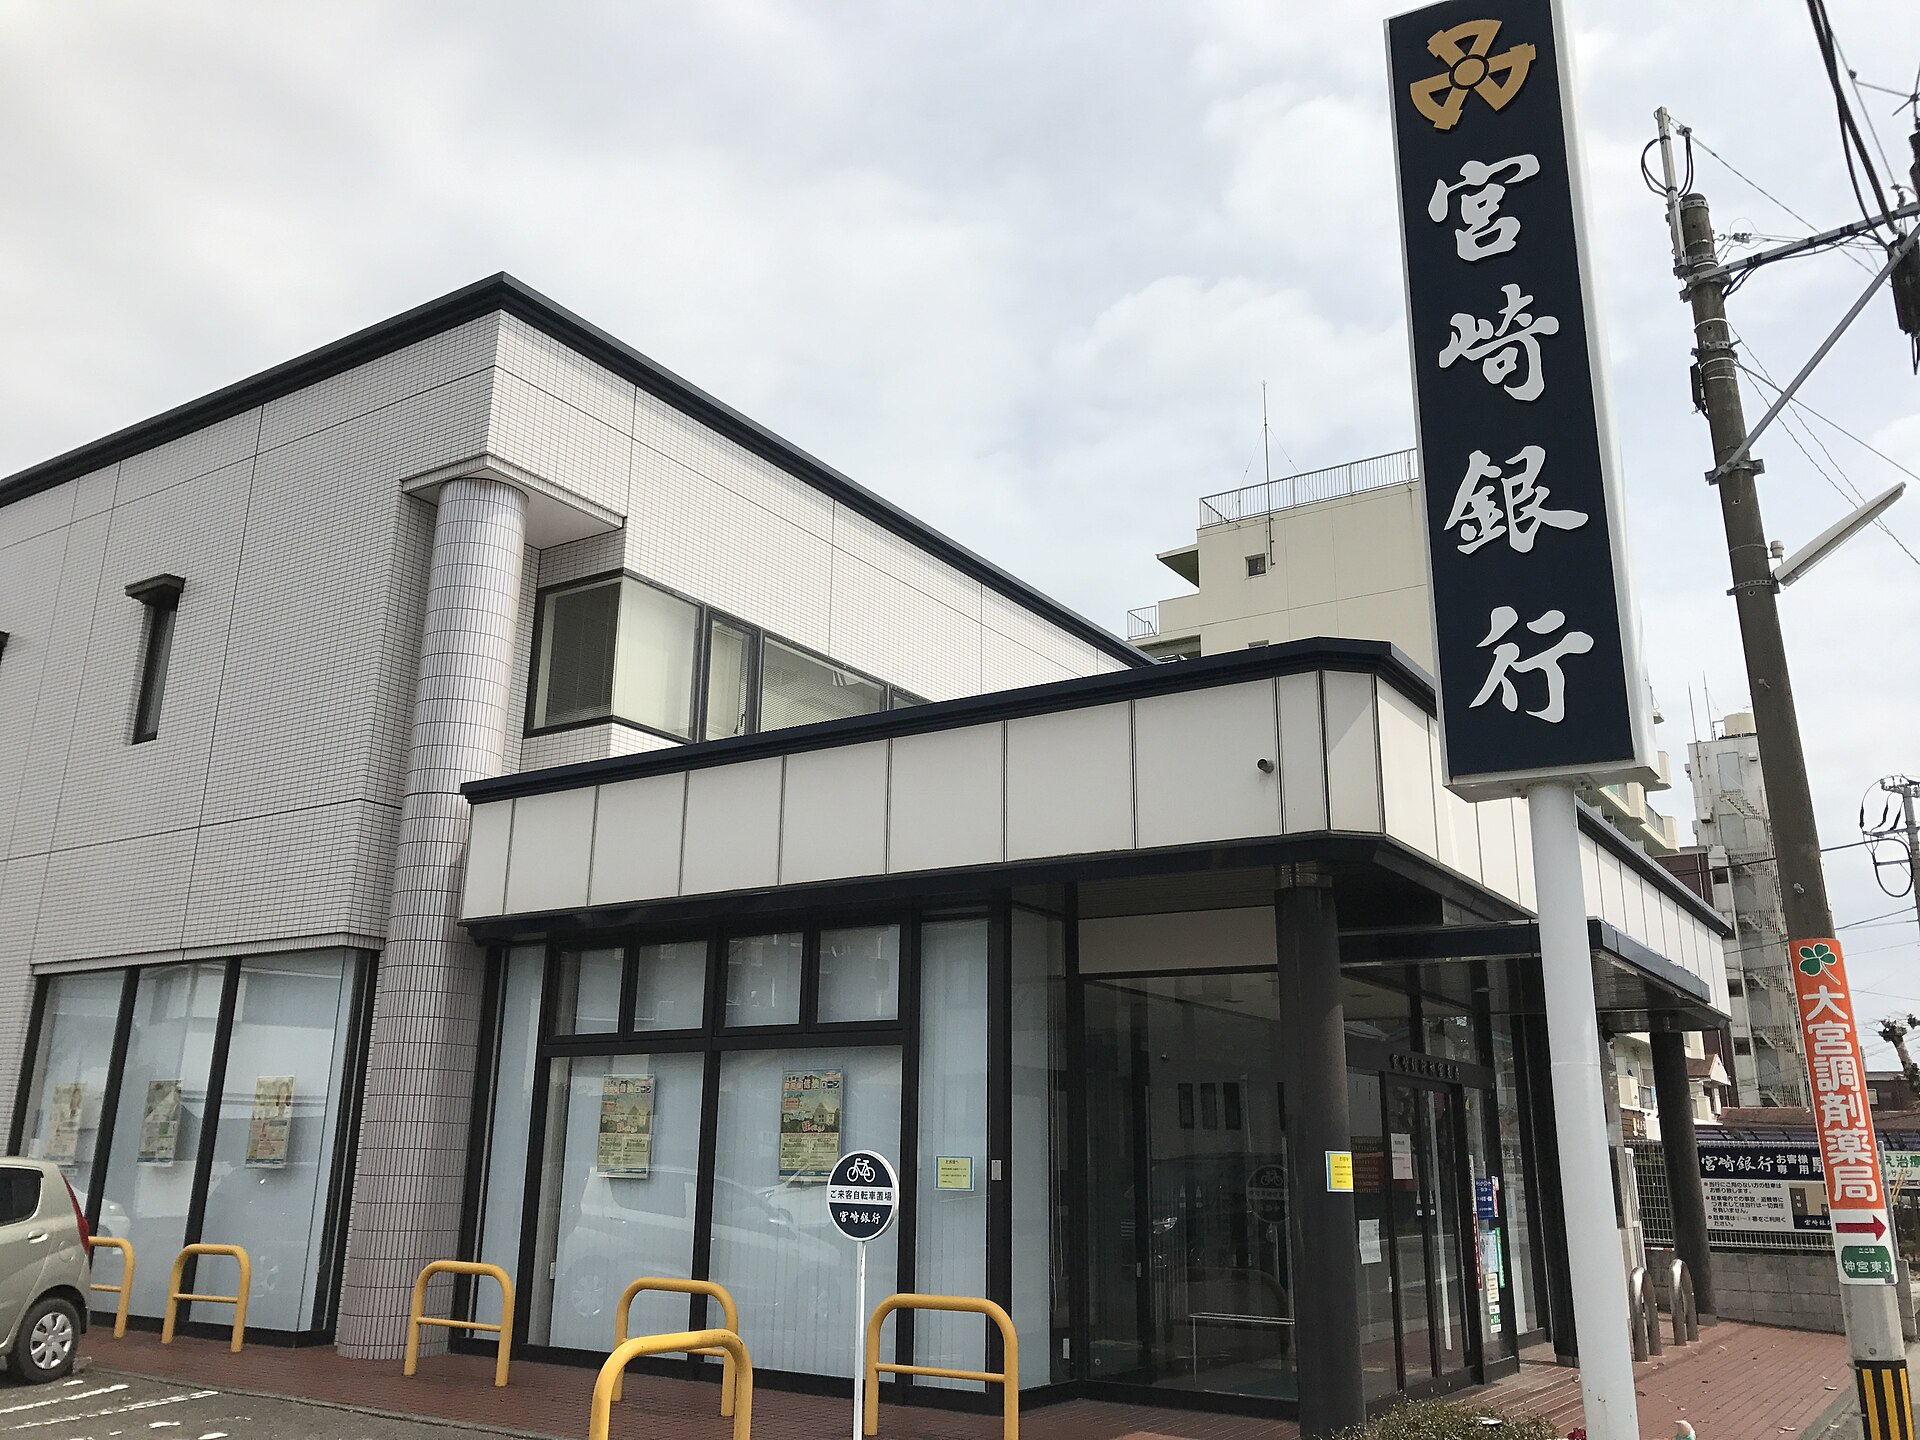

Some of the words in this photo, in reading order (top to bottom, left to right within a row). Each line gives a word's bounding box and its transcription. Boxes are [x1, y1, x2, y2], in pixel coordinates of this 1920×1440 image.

[1428, 154, 1594, 723] 宮崎銀行
[1802, 985, 1878, 1202] 大宮調剤薬局
[1701, 1155, 1774, 1173] 宮崎銀行
[830, 1189, 892, 1201] ご来客自転車置場
[839, 1210, 881, 1224] 宮崎銀行
[1843, 1260, 1891, 1273] 神宮東3
